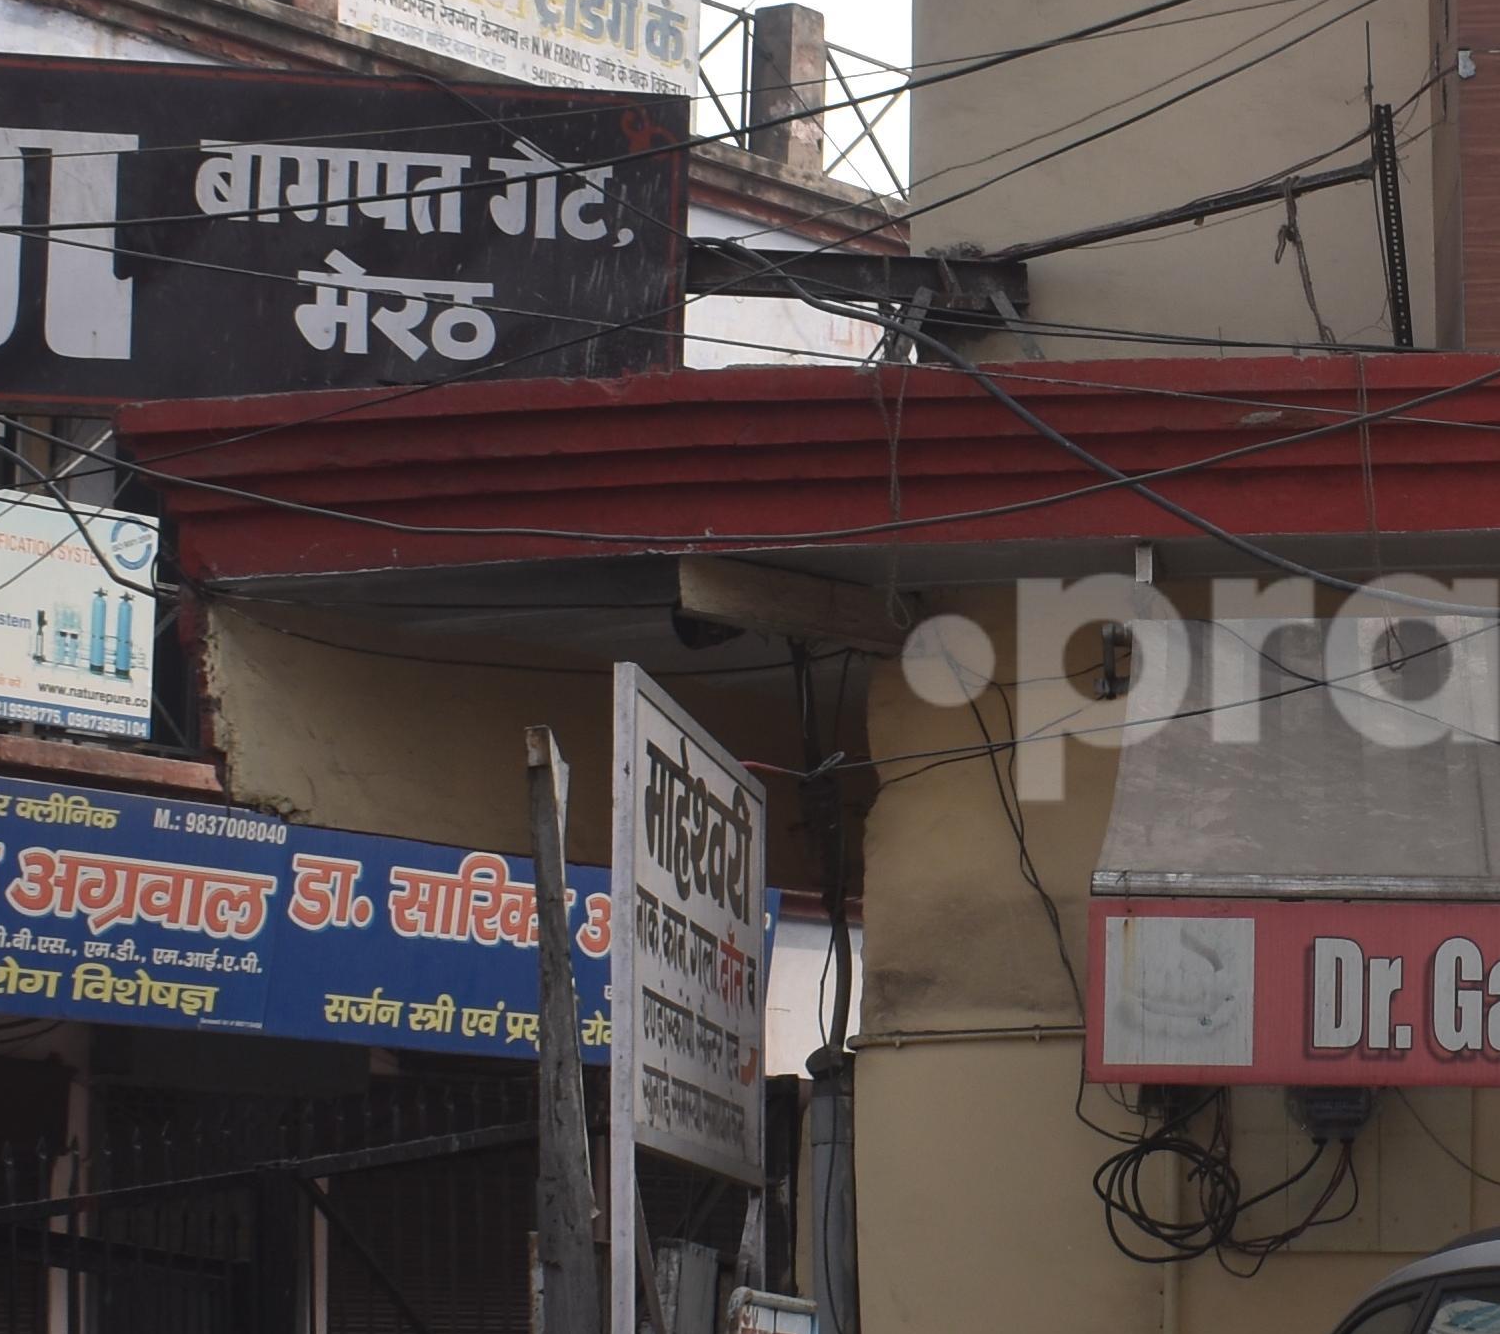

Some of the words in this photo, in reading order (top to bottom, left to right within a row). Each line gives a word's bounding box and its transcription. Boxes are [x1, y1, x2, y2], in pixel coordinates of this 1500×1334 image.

[194, 139, 475, 237] बागपत
[293, 250, 495, 362] मेरठ
[15, 791, 121, 831] क्लीनिक
[184, 810, 288, 846] 9837008040
[6, 845, 277, 939] अग्रवाल
[72, 961, 219, 1017] विशेषज्ञ
[323, 986, 403, 1027] सर्जन
[408, 992, 457, 1034] स्त्री
[460, 1000, 505, 1037] एवं
[1312, 936, 1413, 1050] Dr.
